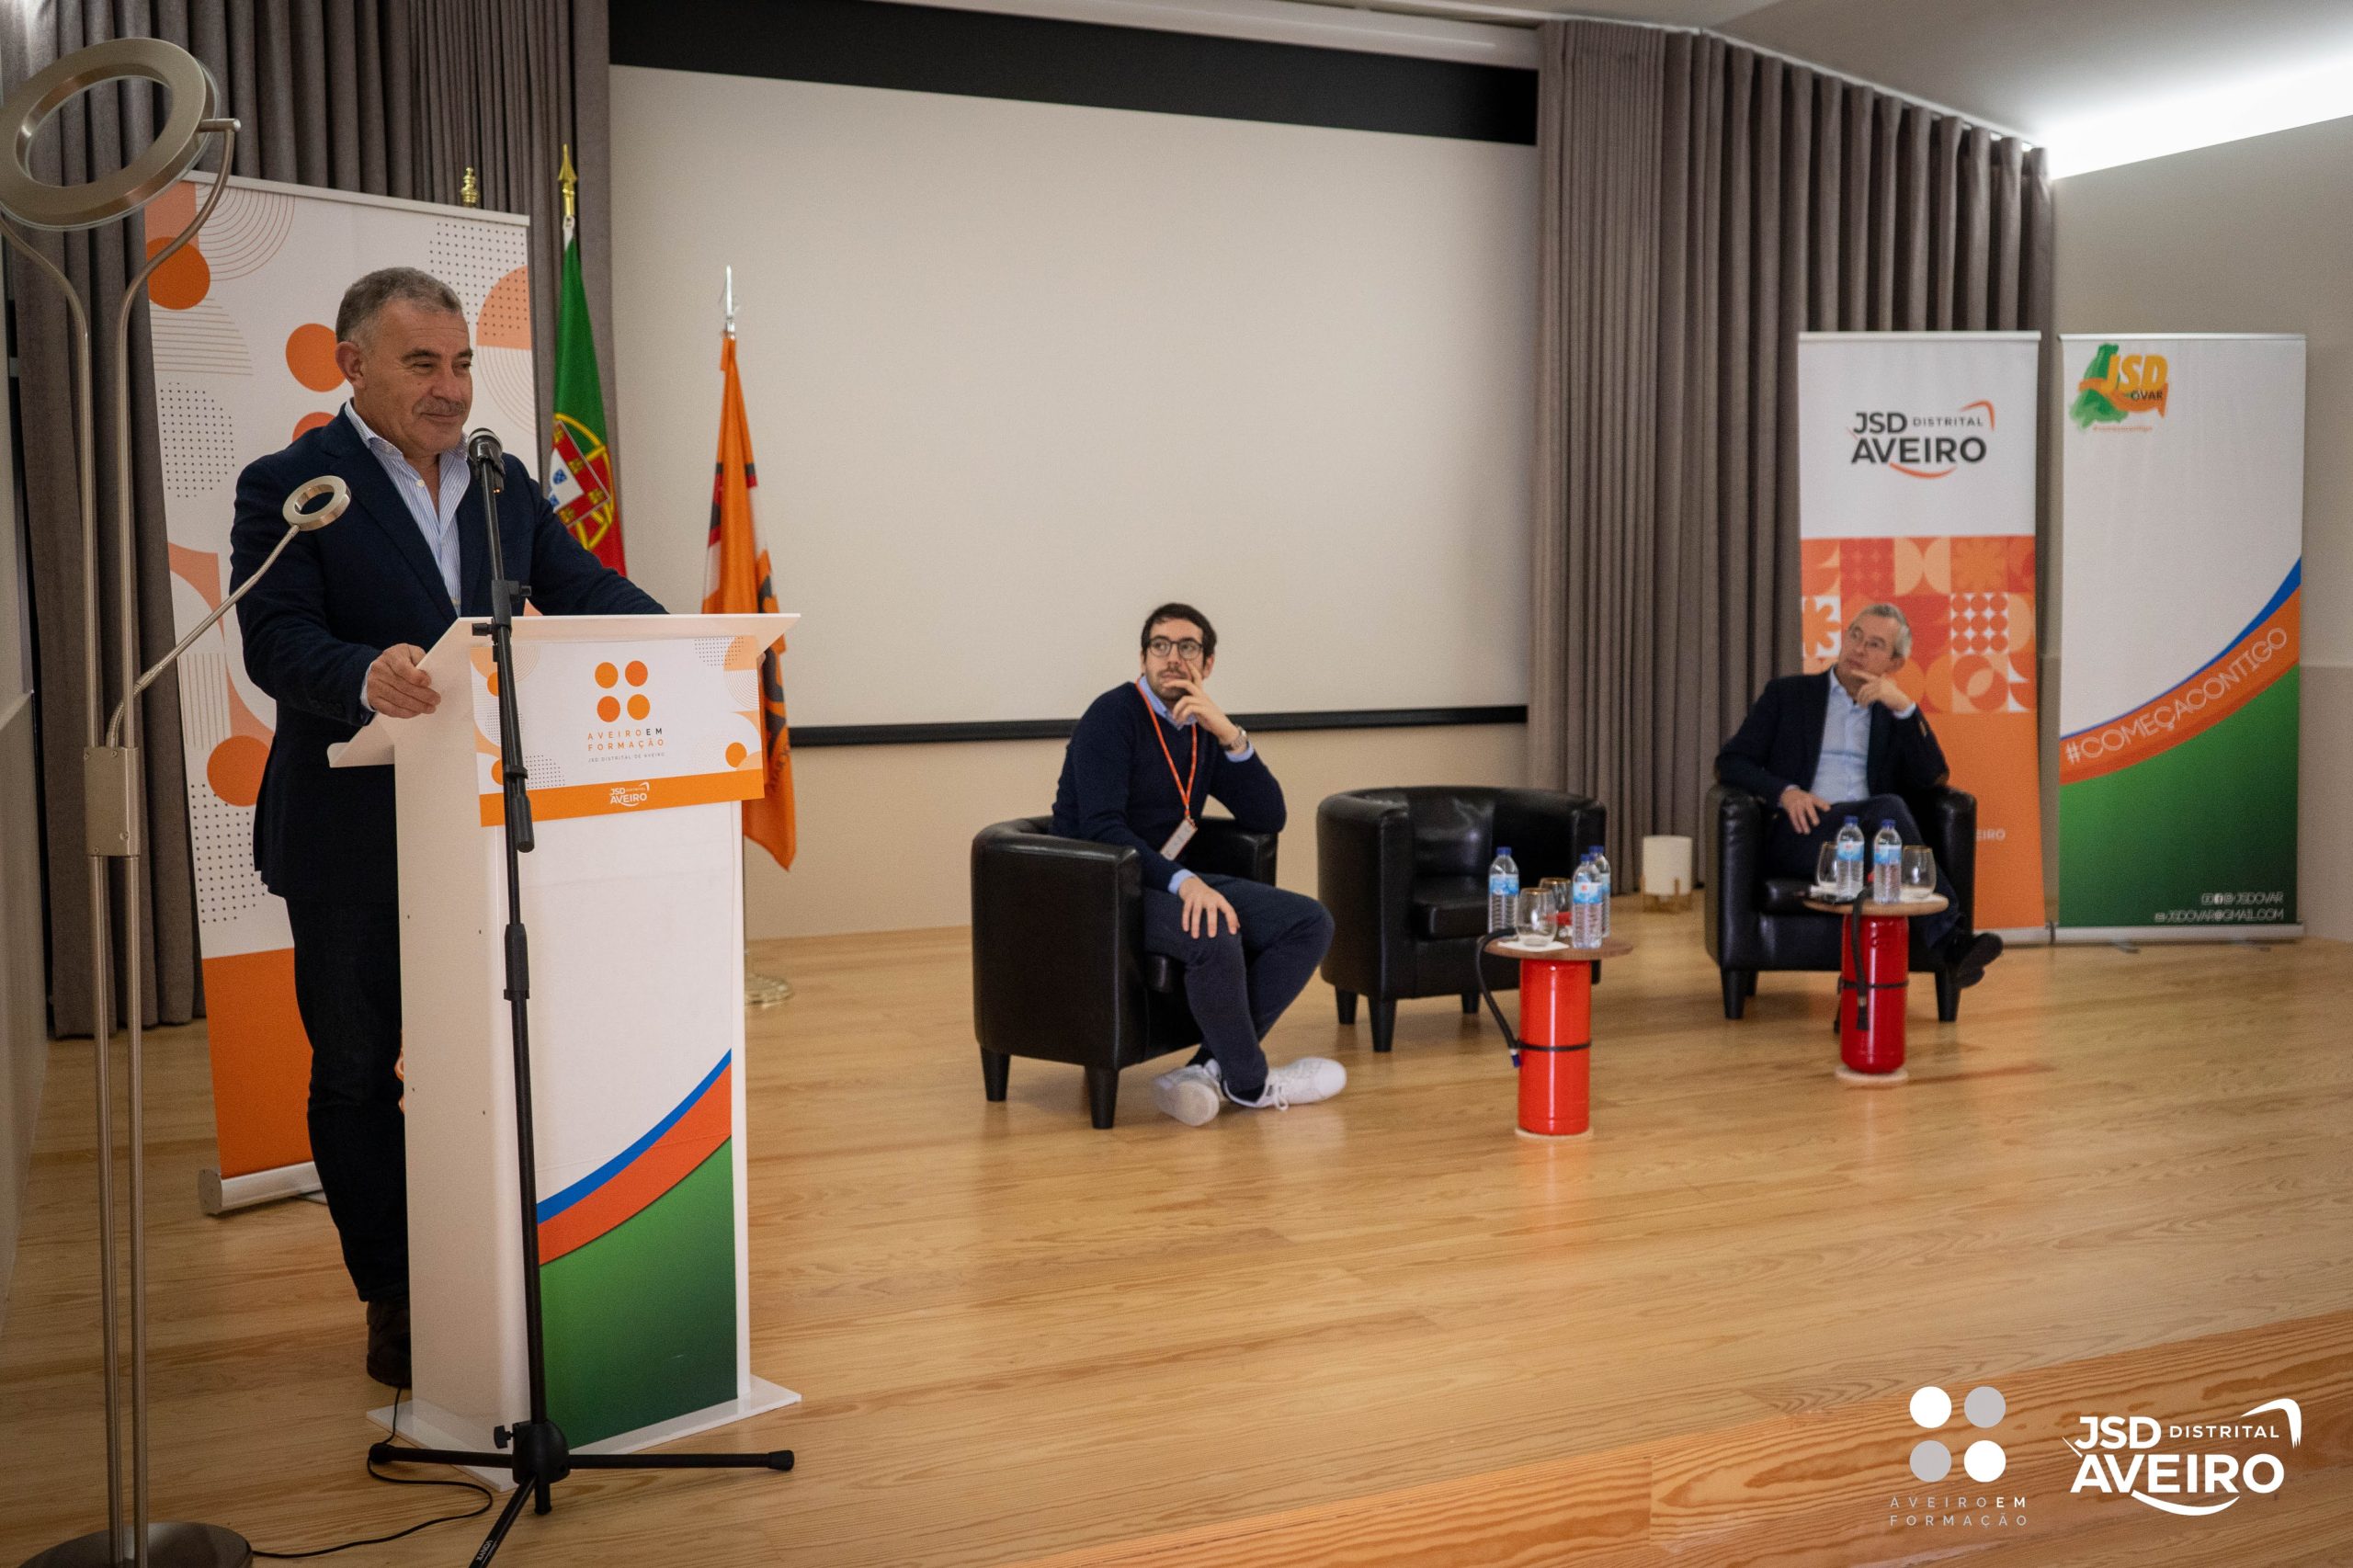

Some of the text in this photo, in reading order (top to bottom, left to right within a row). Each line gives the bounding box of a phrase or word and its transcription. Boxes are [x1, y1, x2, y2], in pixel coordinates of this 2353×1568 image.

[2100, 353, 2169, 392] JSD
[1853, 412, 1984, 434] JSD DISTRITAL
[1851, 437, 1987, 464] AVEIRO
[2065, 627, 2288, 764] #COMEÇACONTIGO
[588, 738, 664, 751] FORMAÇÃO
[610, 787, 626, 796] JSD
[610, 793, 648, 804] AVEIRO
